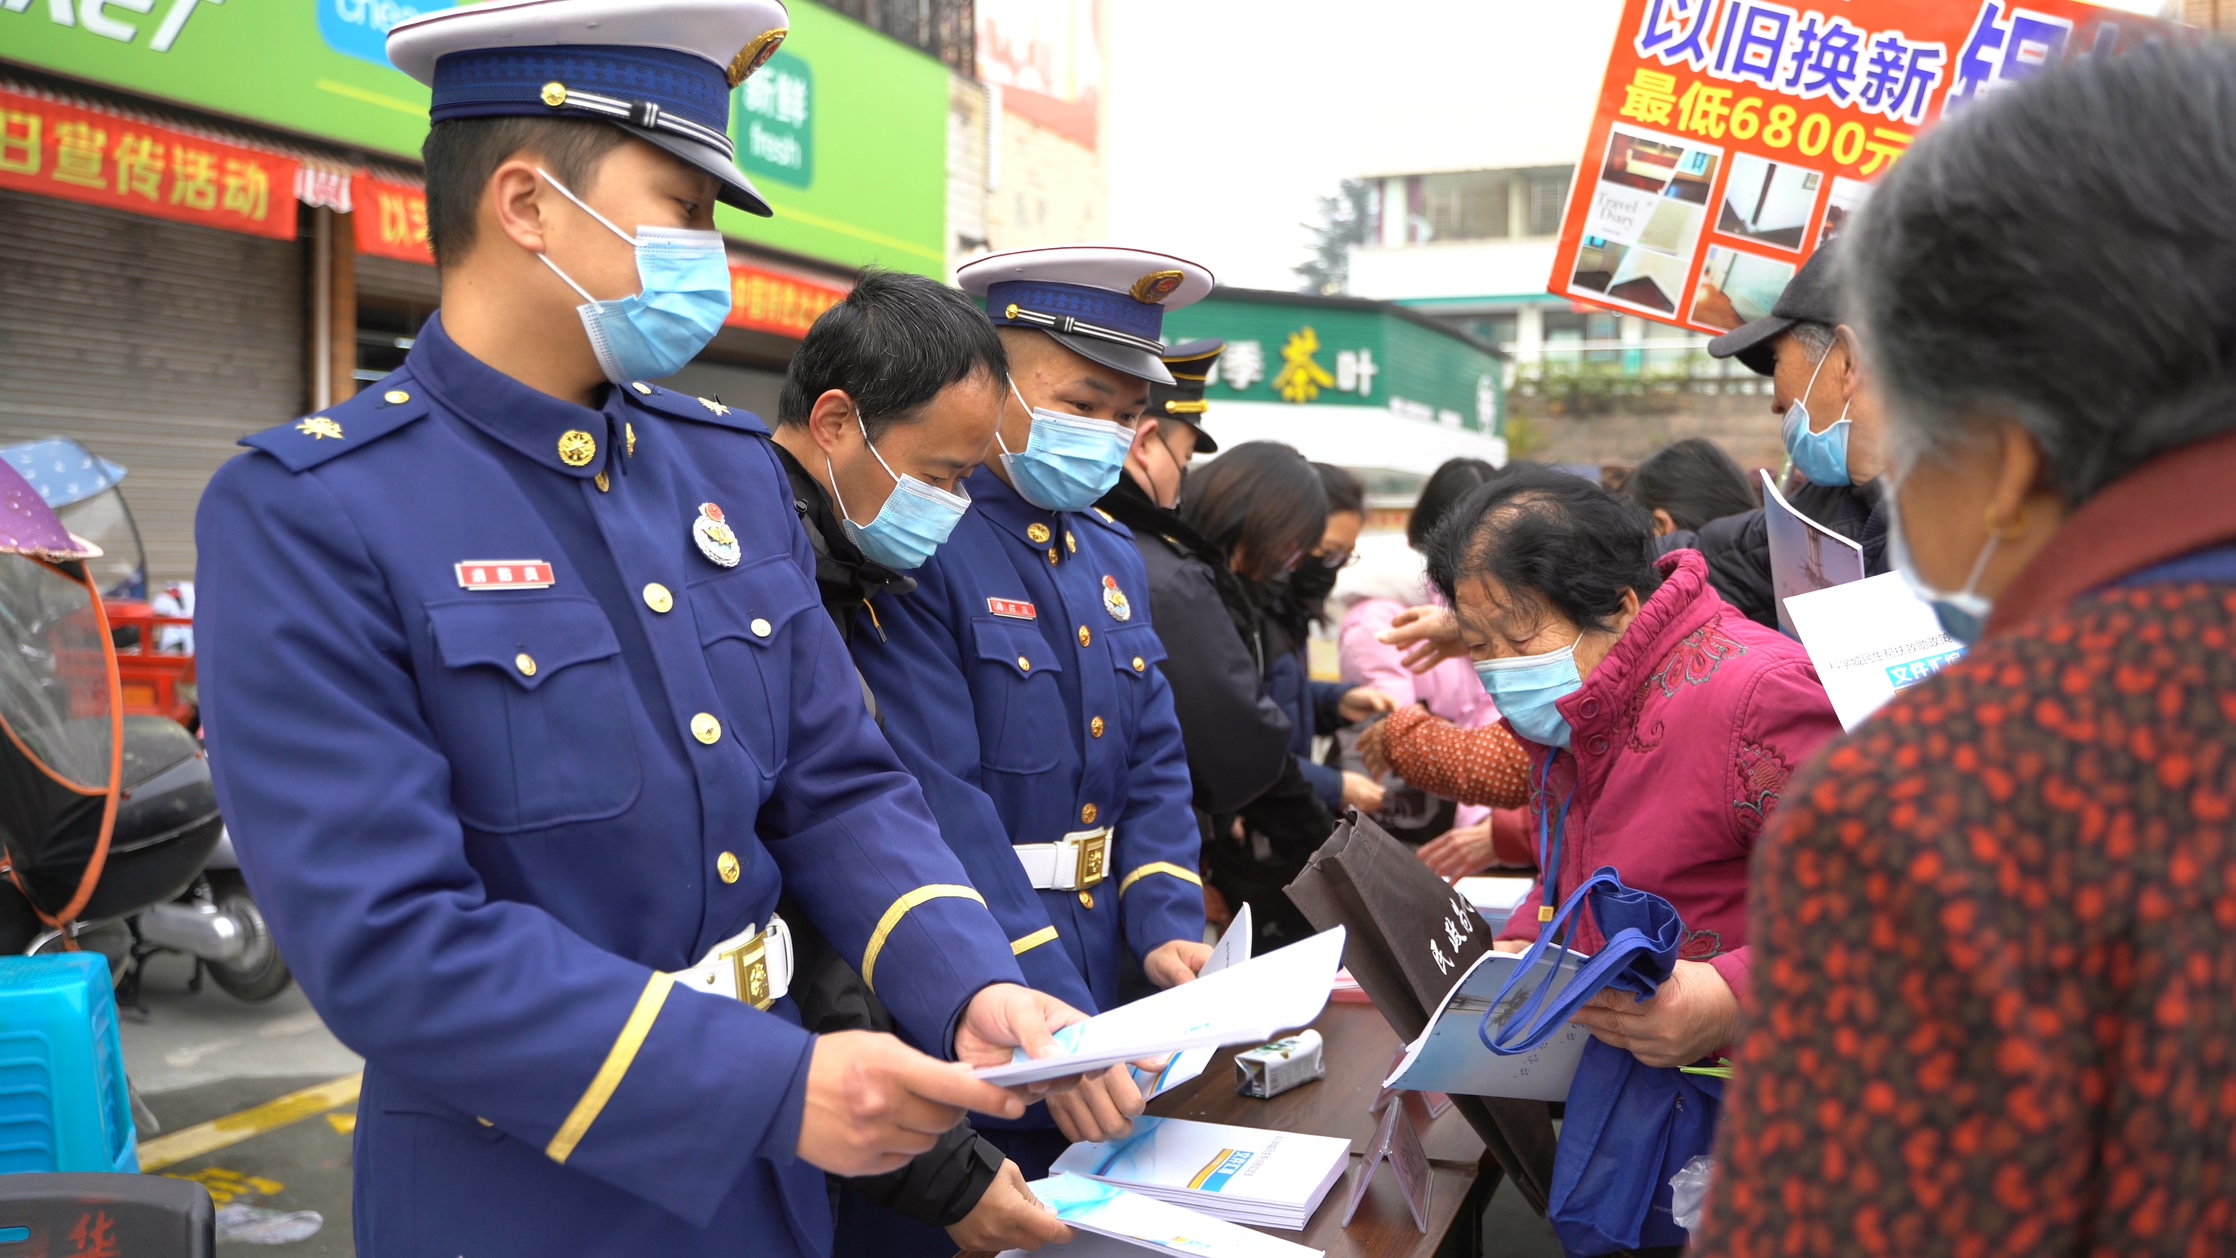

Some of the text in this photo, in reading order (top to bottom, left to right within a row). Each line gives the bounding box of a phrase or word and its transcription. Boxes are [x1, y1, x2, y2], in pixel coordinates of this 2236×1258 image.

[1635, 0, 1944, 121] 以旧换新
[0, 107, 269, 222] 日宣传活动
[749, 119, 802, 170] fresh
[1618, 66, 1914, 176] 最低6800元
[1205, 326, 1379, 404] 季茶叶
